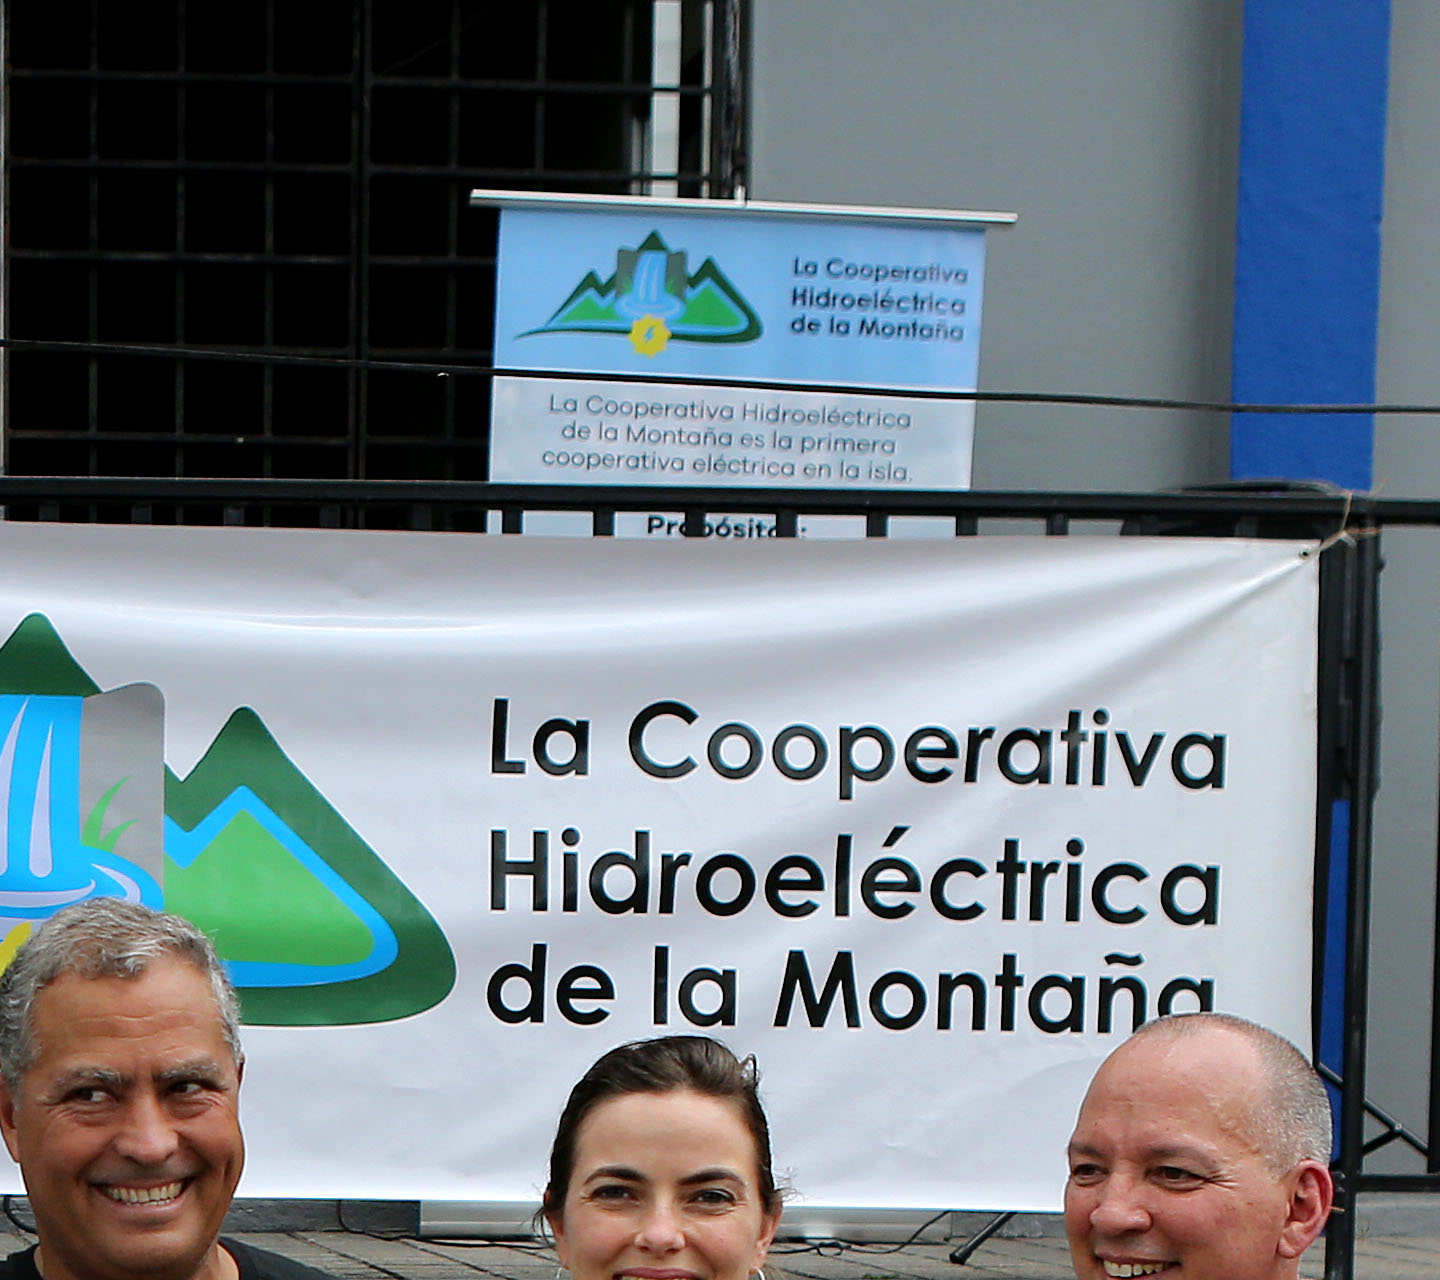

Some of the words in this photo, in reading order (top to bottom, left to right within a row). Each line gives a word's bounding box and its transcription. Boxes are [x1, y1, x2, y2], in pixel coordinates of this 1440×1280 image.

[793, 255, 818, 276] La
[826, 257, 968, 284] Cooperativa
[791, 285, 966, 314] Hidroeléctrica
[790, 312, 820, 335] de
[829, 313, 850, 336] la
[858, 317, 964, 342] Montaña
[549, 394, 578, 414] La
[586, 395, 735, 422] Cooperativa
[742, 402, 912, 429] Hidroeléctrica
[561, 420, 591, 441] de
[598, 421, 619, 442] la
[626, 424, 732, 448] Montaña
[740, 432, 766, 449] es
[772, 429, 793, 450] la
[800, 433, 896, 456] primera
[542, 448, 685, 473] cooperativa
[692, 454, 796, 478] eléctrica
[803, 462, 832, 479] en
[839, 457, 861, 480] la
[868, 460, 913, 482] isla.
[491, 697, 591, 777] La
[628, 699, 1227, 800] Cooperativa
[489, 825, 1221, 926] Hidroeléctrica
[486, 943, 616, 1026] de
[652, 944, 737, 1028] la
[773, 948, 1215, 1035] Montaña
